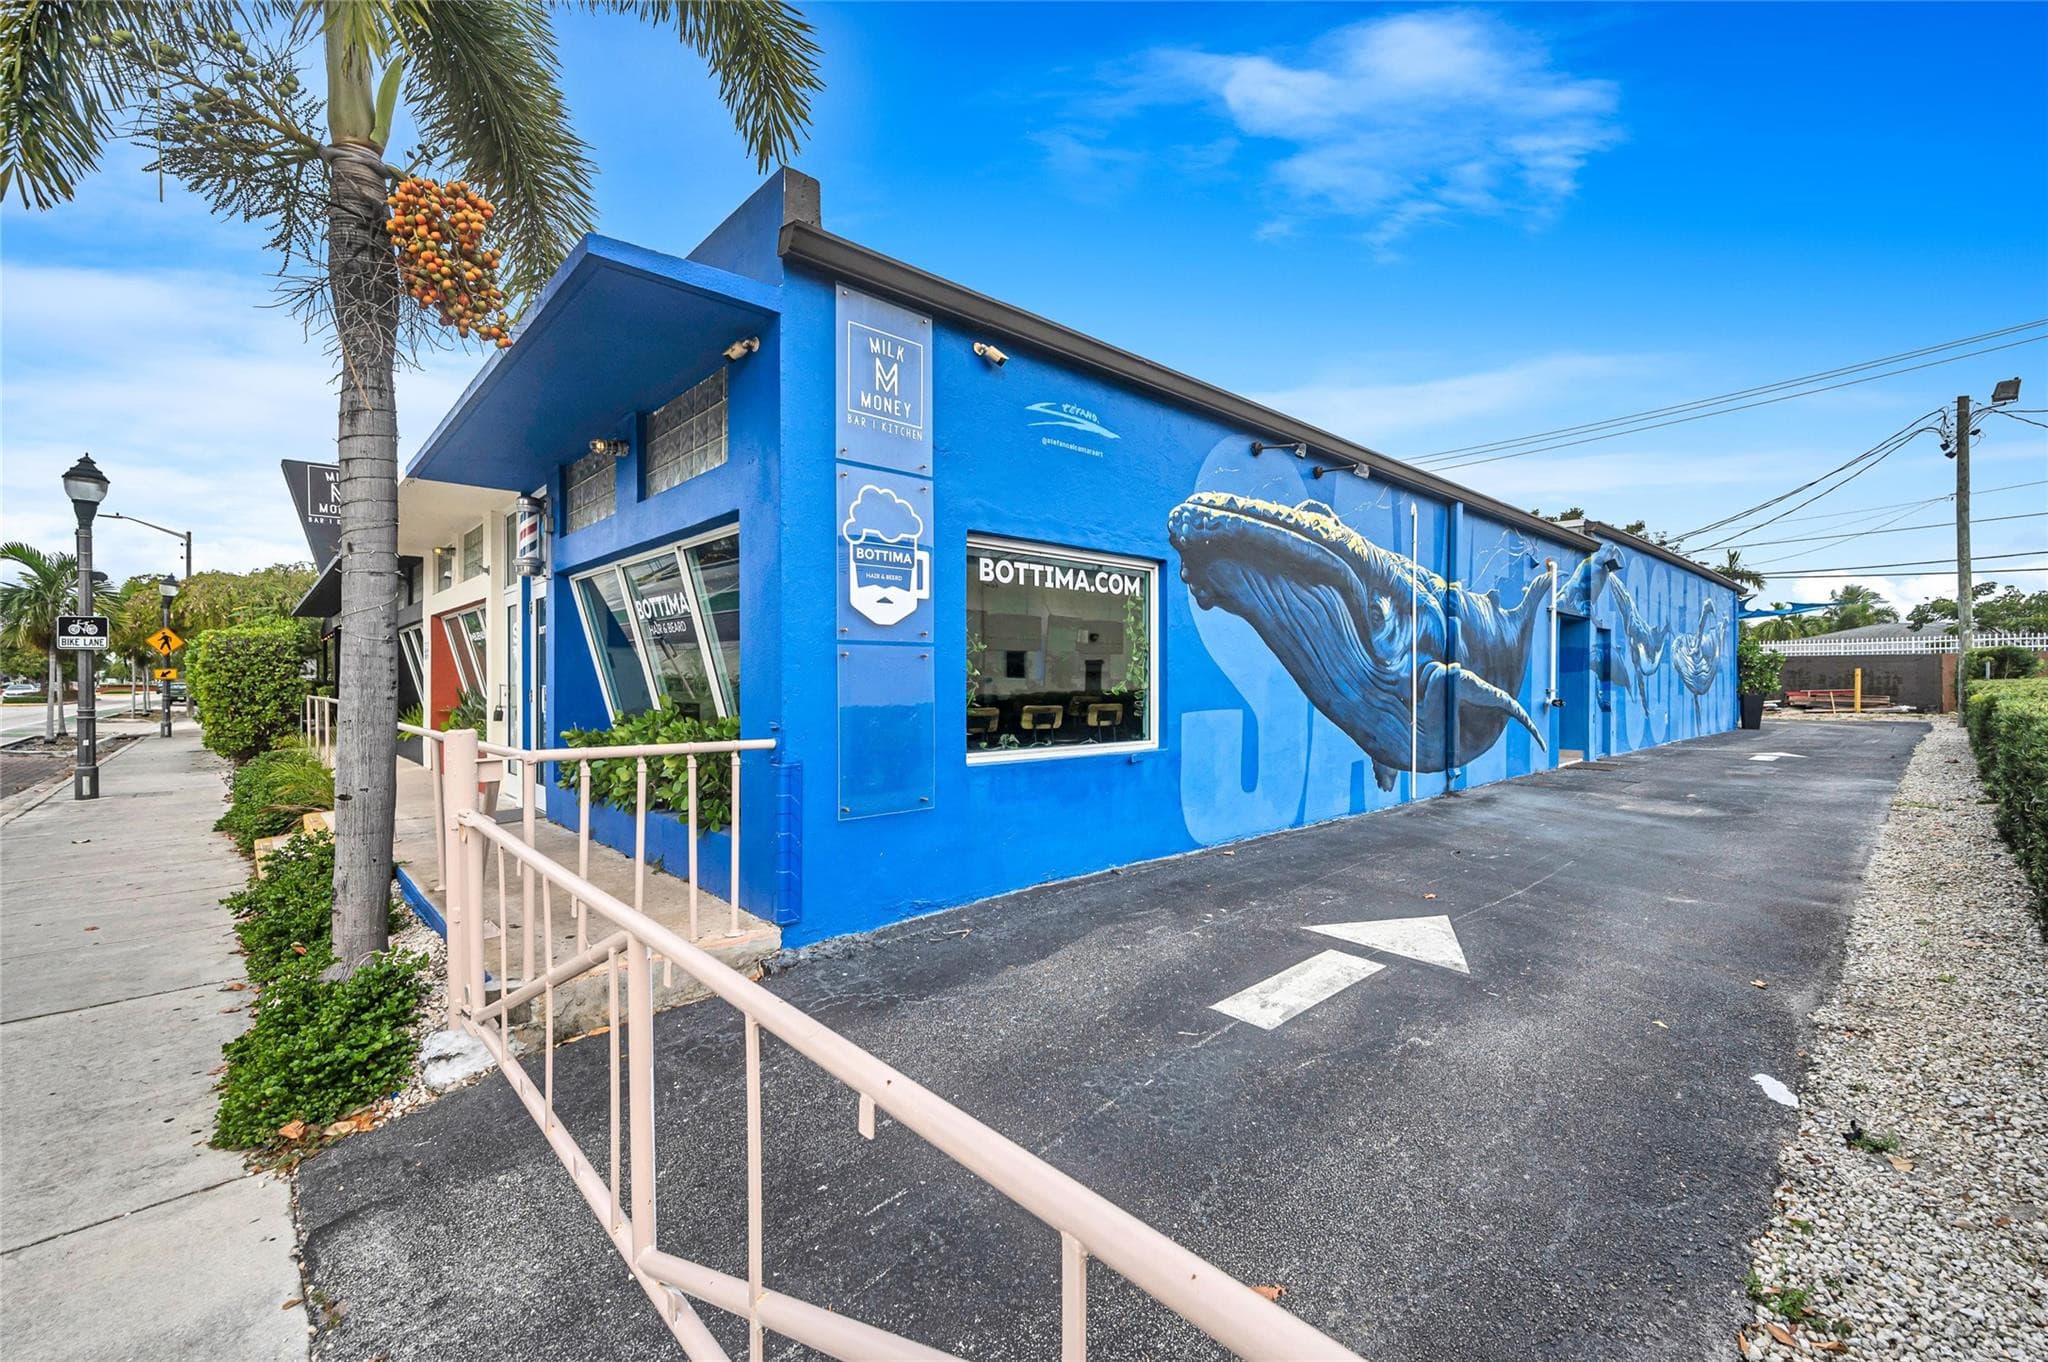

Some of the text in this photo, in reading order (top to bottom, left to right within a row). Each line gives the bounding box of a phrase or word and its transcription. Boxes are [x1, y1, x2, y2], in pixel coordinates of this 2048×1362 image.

[869, 336, 905, 363] MILK
[860, 390, 912, 419] MONEY
[847, 414, 867, 428] BAR
[881, 422, 923, 441] KITCHEN
[308, 517, 324, 525] BAR
[855, 547, 913, 565] BOTTIMA
[979, 557, 1141, 597] BOTTIMA.COM
[635, 592, 690, 619] BOTTIMA
[649, 621, 687, 634] HAIR & BEARD
[62, 638, 104, 647] BIKE LANE
